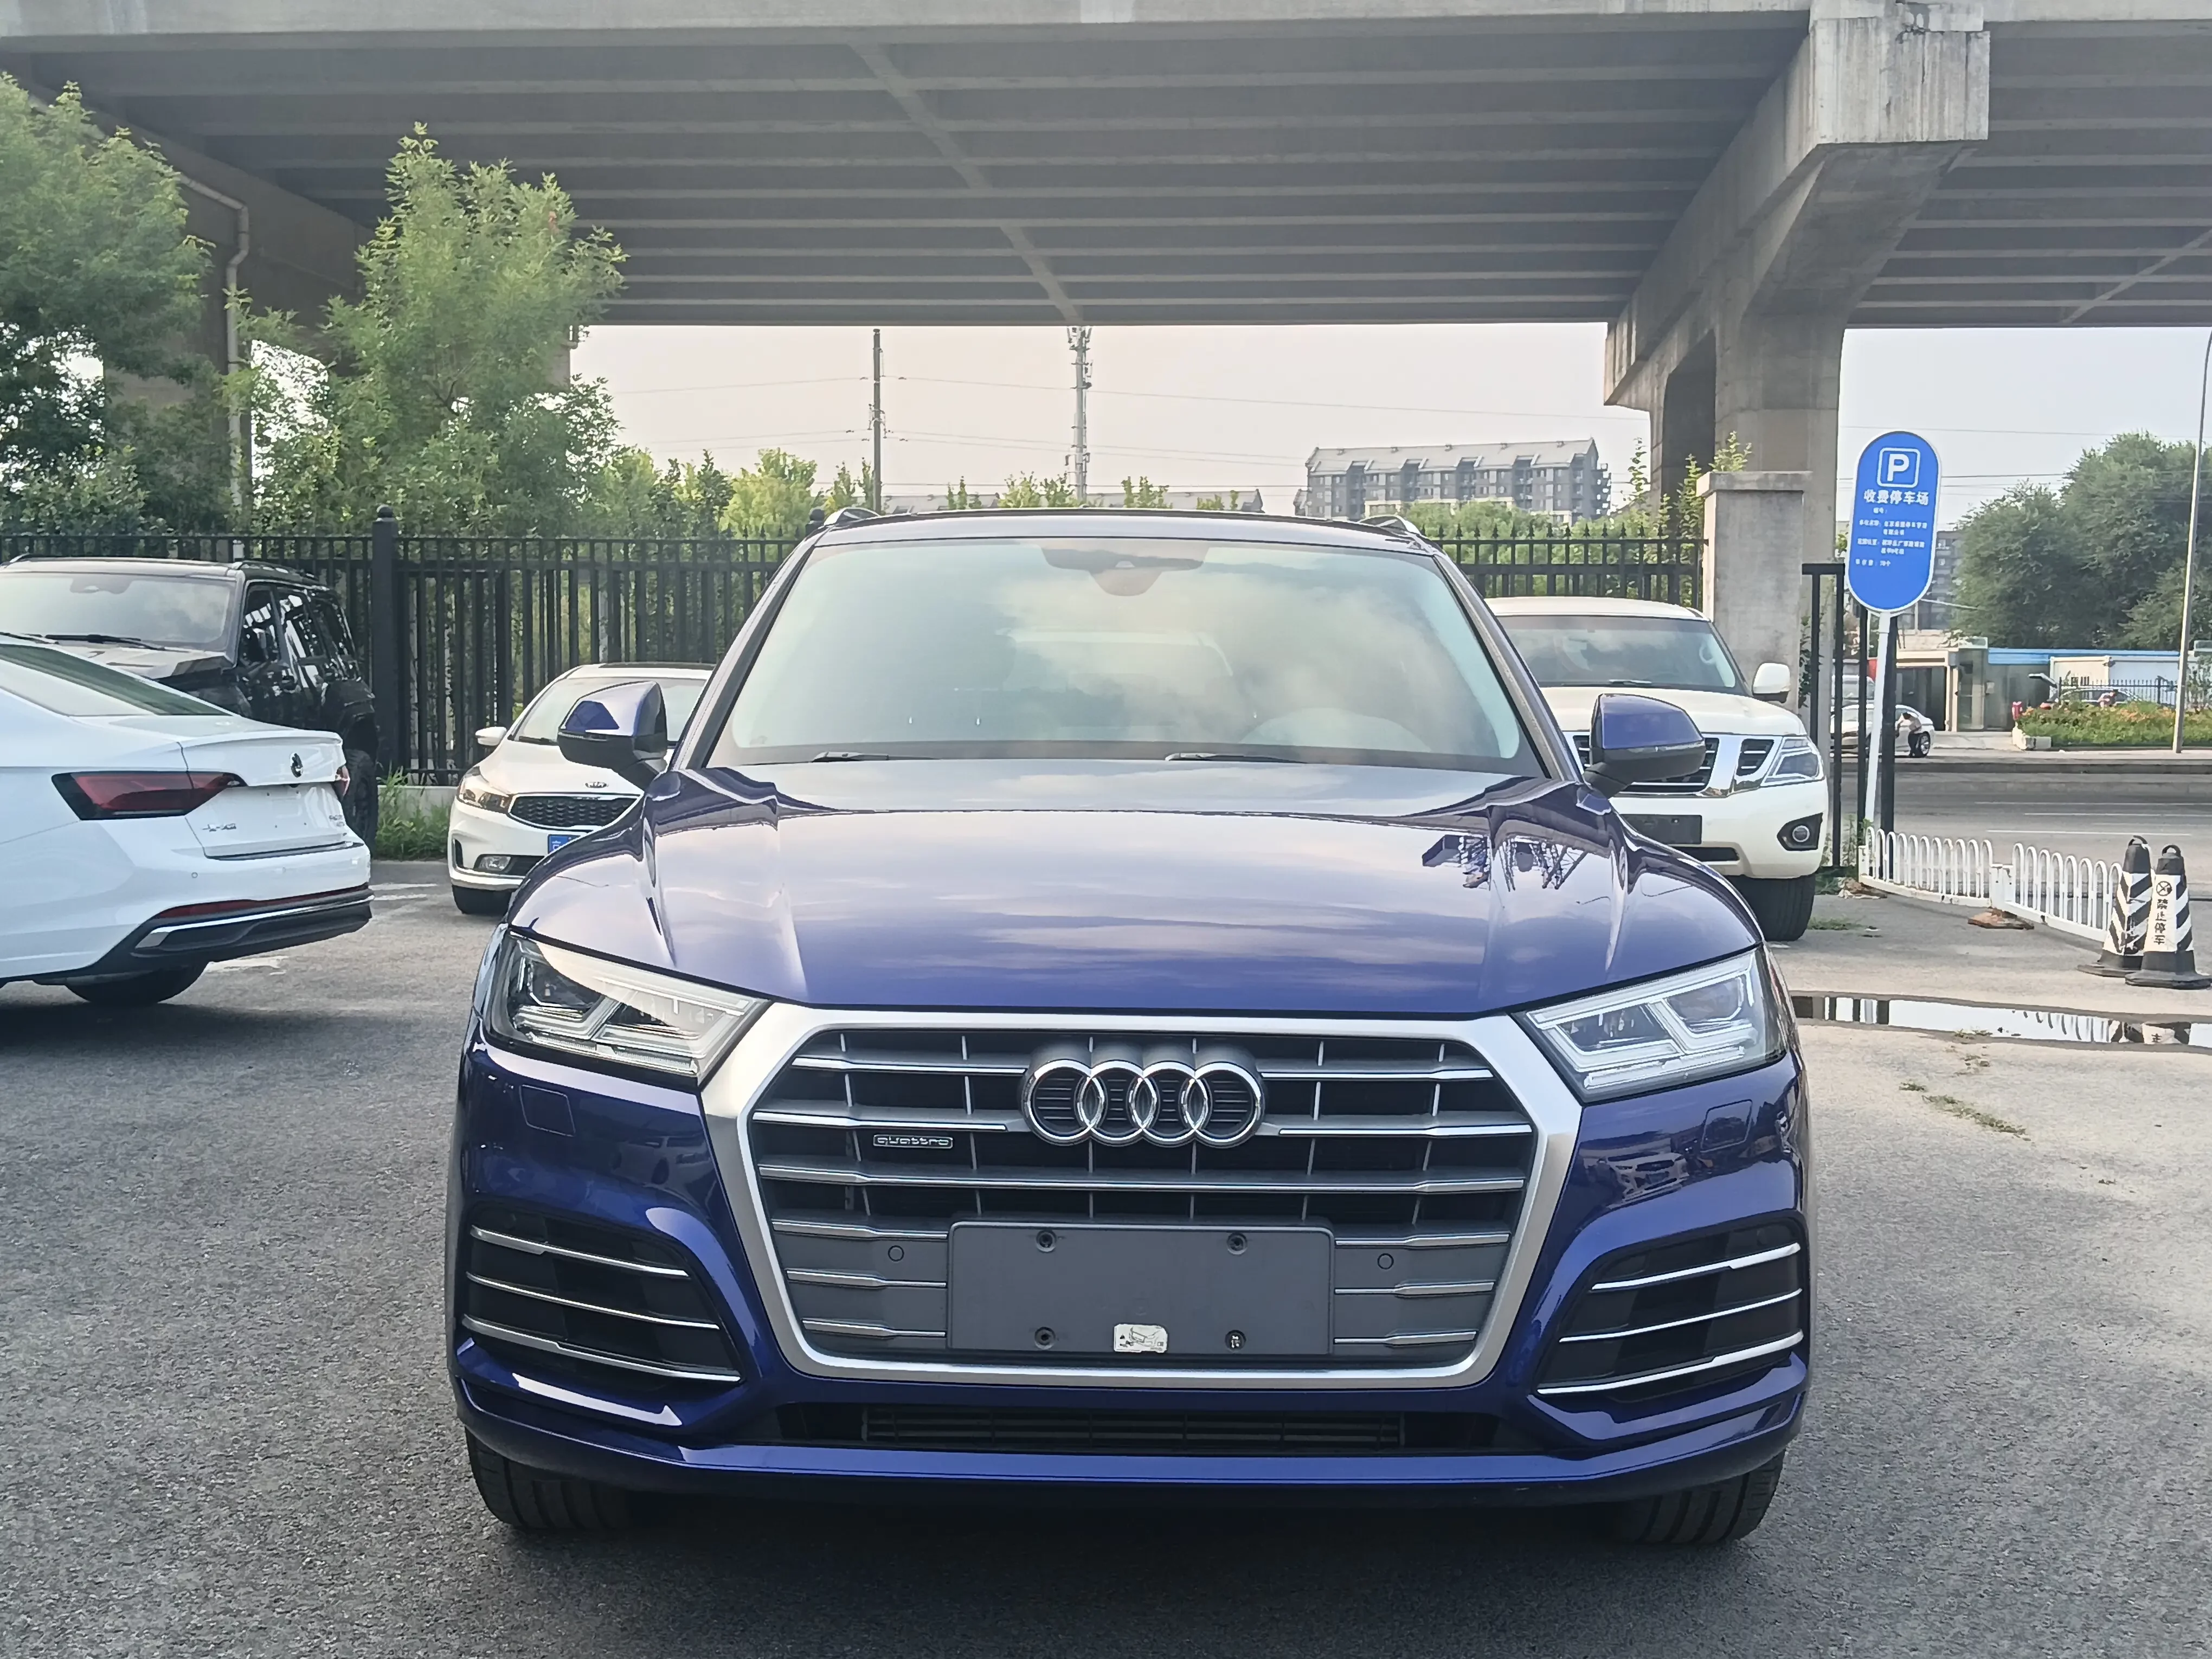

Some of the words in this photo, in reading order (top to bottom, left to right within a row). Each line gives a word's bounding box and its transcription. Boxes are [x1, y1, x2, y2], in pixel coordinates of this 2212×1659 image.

[1887, 453, 1909, 481] P
[1863, 489, 1928, 505] 收费停车场
[877, 1136, 949, 1146] quattro
